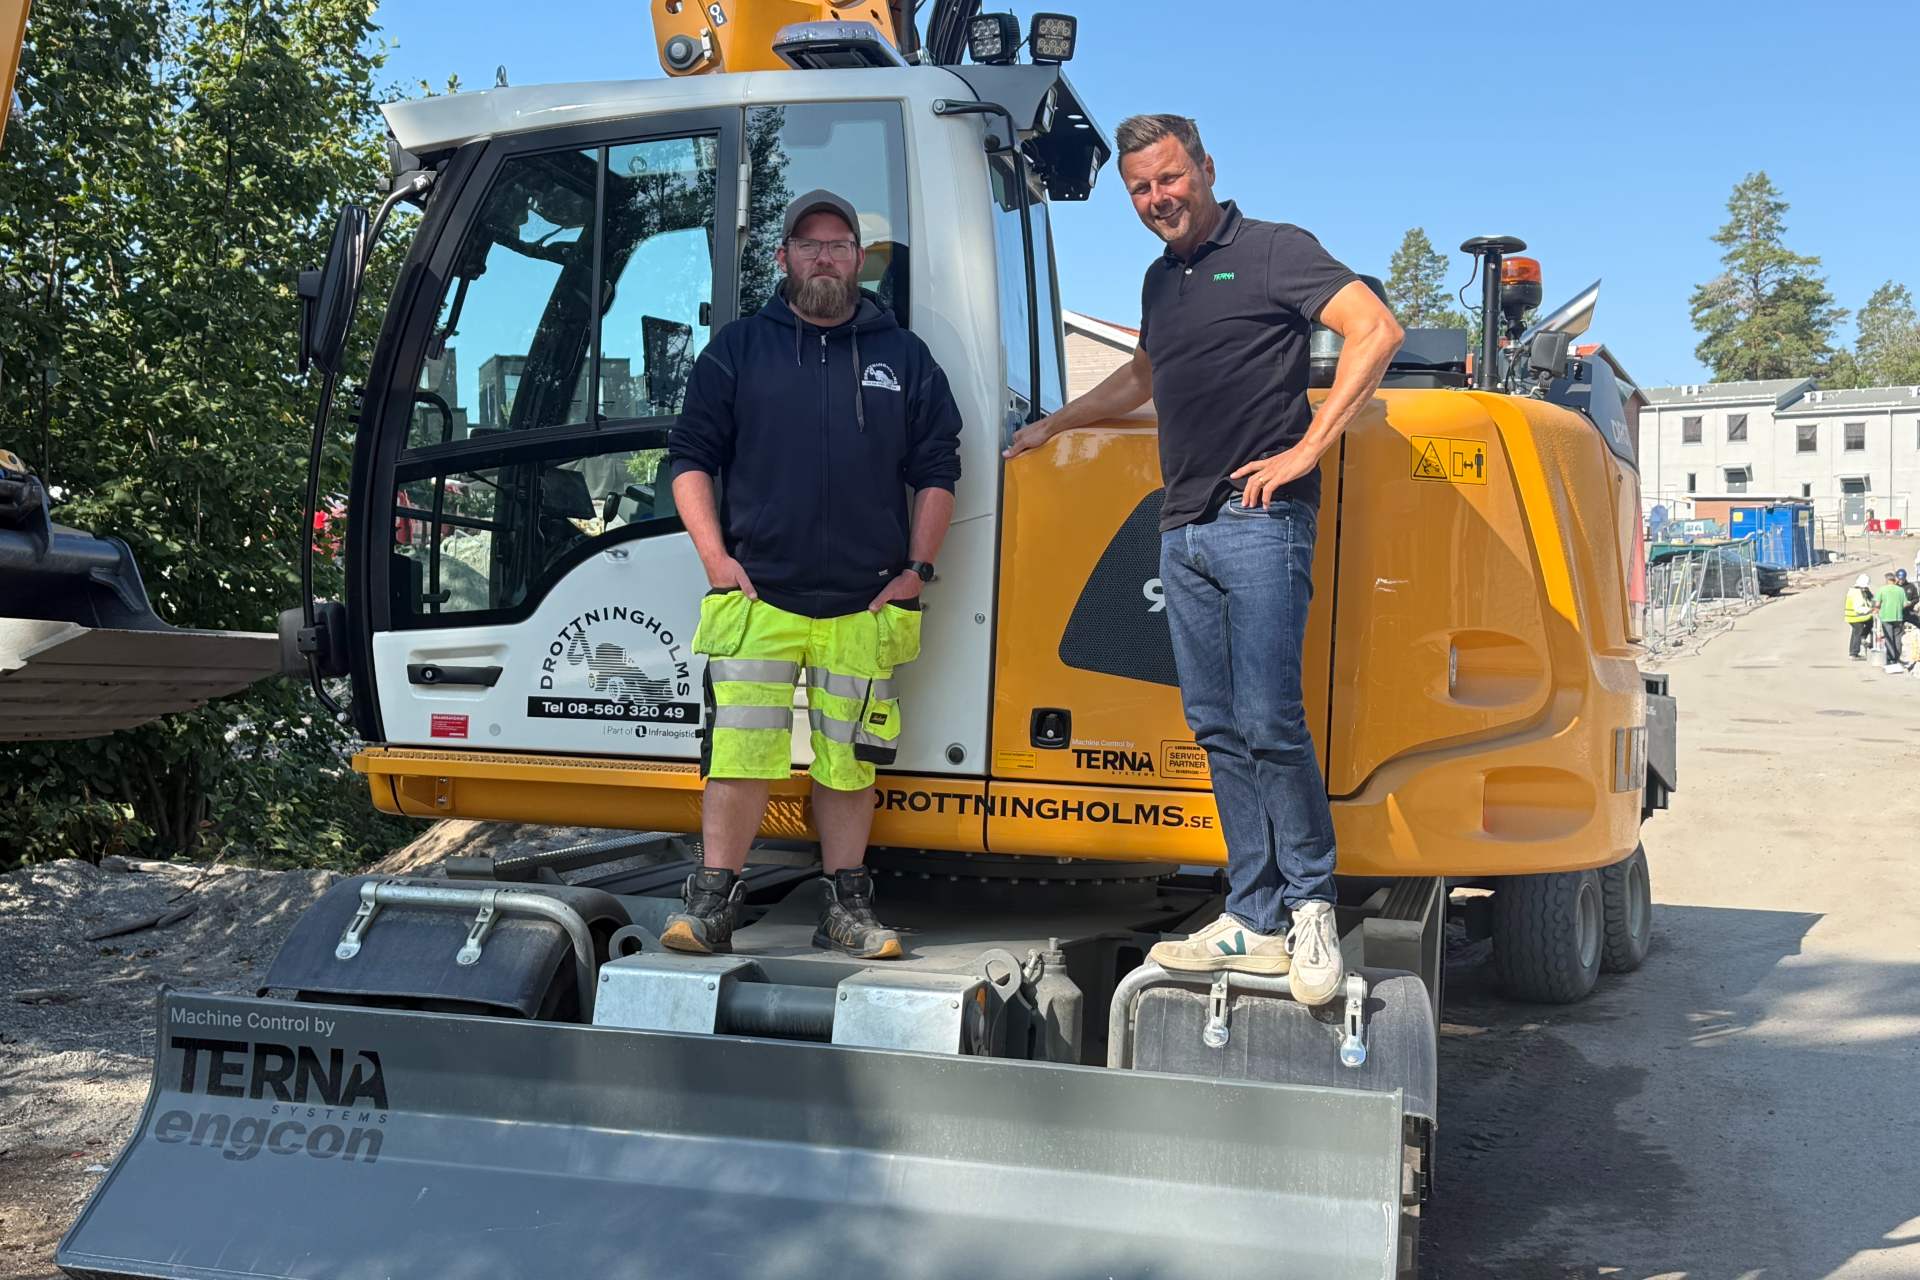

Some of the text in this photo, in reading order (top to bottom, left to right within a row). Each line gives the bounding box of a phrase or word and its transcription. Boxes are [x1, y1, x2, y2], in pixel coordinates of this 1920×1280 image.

[540, 606, 690, 696] DROTTNINGHOLMS
[542, 701, 685, 719] Tel 08-560 320 49
[607, 726, 624, 736] Part
[625, 727, 633, 736] of
[1071, 749, 1154, 772] TERNA
[1169, 752, 1206, 761] SERVICE
[1169, 760, 1206, 769] PARTNER
[171, 1007, 336, 1037] Machine Control by
[171, 1036, 389, 1110] TERNA
[271, 1104, 389, 1124] SYSTEMS
[154, 1109, 384, 1163] engcon
